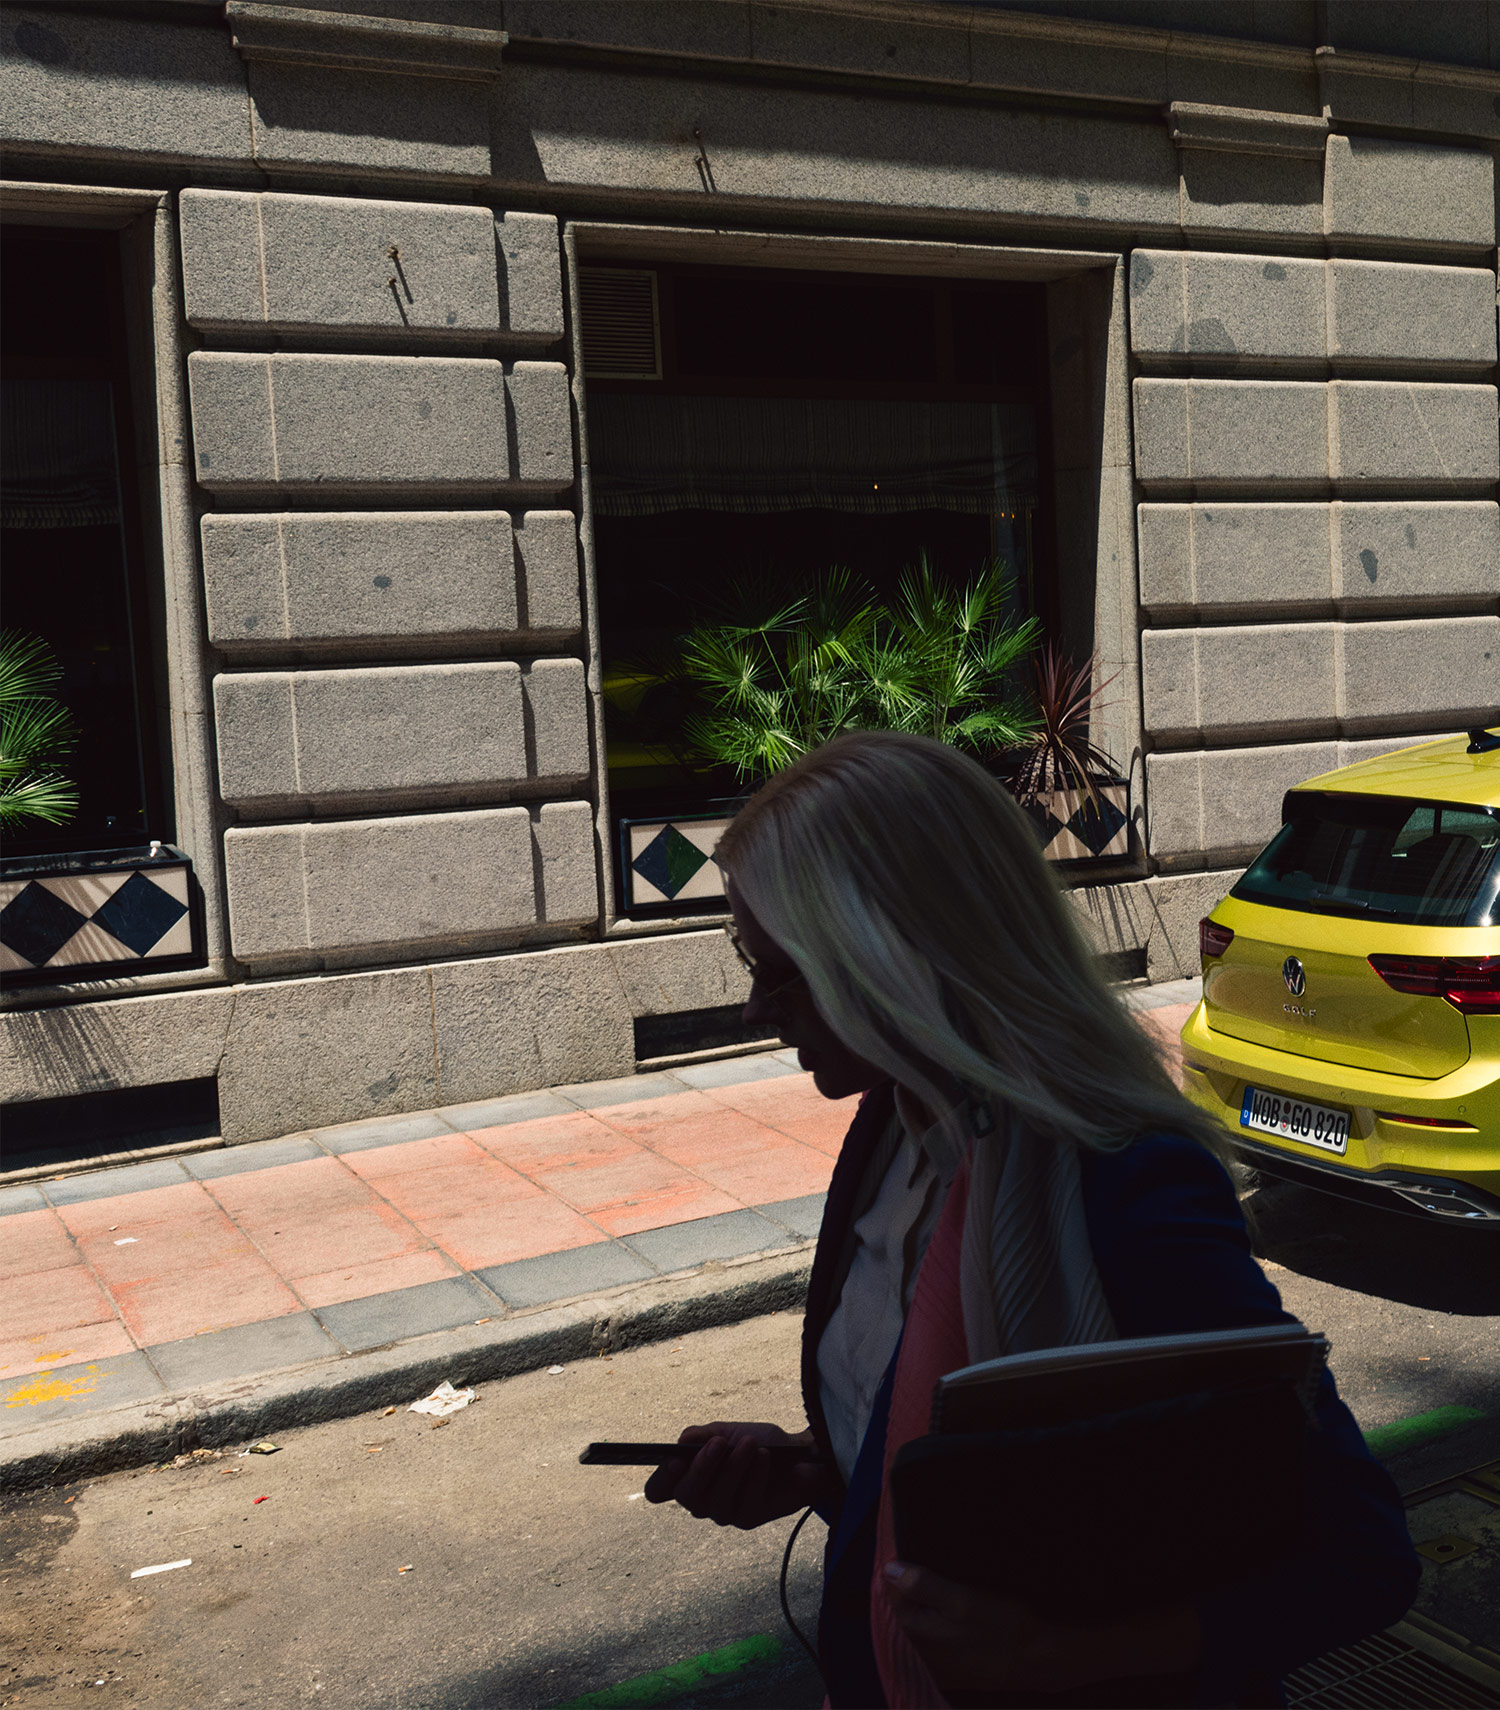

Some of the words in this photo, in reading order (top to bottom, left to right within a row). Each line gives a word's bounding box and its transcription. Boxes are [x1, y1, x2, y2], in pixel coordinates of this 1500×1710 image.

[1283, 1004, 1316, 1018] GOLF
[1252, 1093, 1281, 1127] WOB
[1291, 1104, 1312, 1136] GO
[1314, 1111, 1346, 1146] 820
